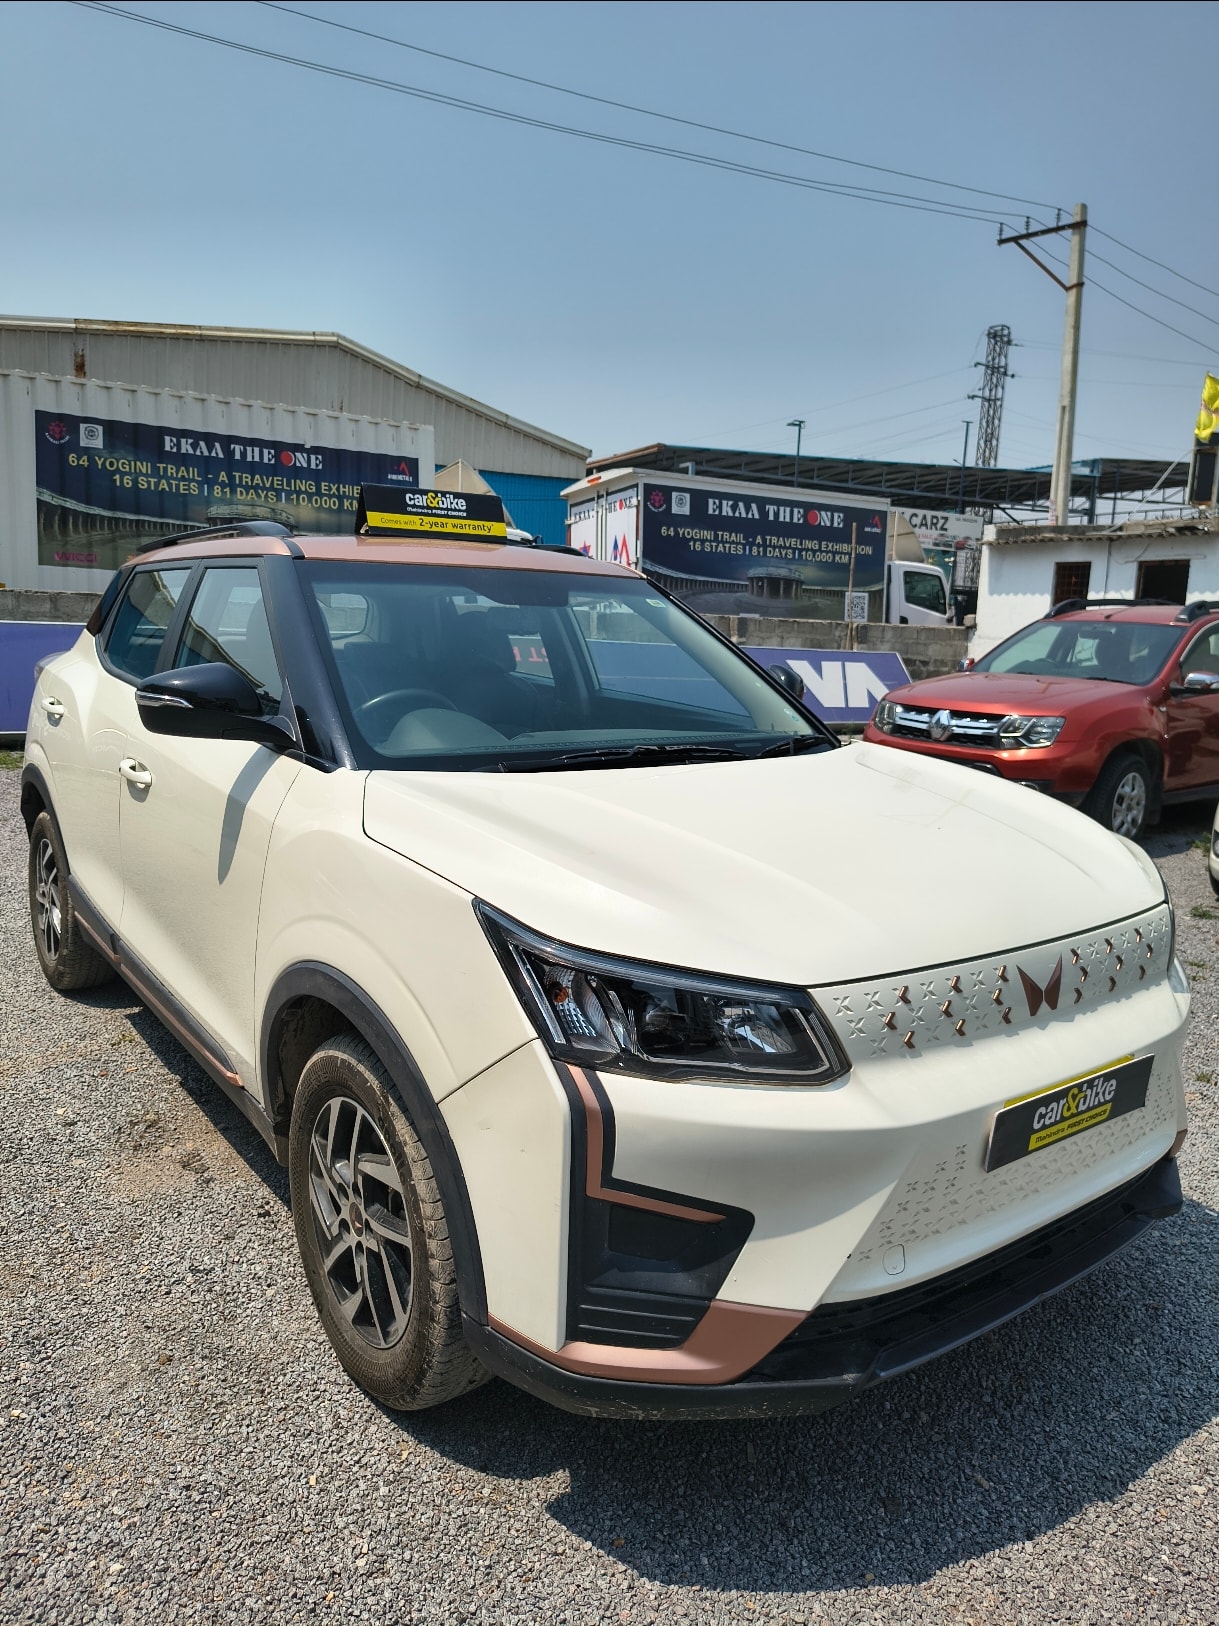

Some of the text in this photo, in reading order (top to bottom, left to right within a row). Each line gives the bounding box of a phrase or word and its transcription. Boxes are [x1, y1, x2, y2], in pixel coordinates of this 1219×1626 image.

[164, 436, 322, 469] EKAA THE ONE
[68, 453, 89, 467] 64
[95, 456, 151, 474] YOGINI
[157, 463, 202, 480] TRAIL
[218, 471, 229, 483] A
[233, 472, 315, 493] TRAVELING
[113, 474, 132, 488] 16
[138, 478, 199, 495] STATES
[213, 486, 230, 498] 81
[237, 488, 277, 502] DAYS
[291, 494, 339, 510] 10,000
[405, 492, 467, 510] car&bike
[380, 517, 401, 525] Comes
[419, 517, 449, 529] 2-year
[707, 498, 844, 528] EKAA THE ONE
[909, 513, 949, 531] CARZ
[661, 526, 675, 537] 64
[677, 527, 714, 539] YOGINI
[716, 531, 746, 543] TRAIL
[755, 535, 762, 545] A
[765, 536, 819, 550] TRAVELING
[688, 541, 701, 552] 16
[705, 543, 743, 555] STATES
[751, 547, 762, 556] 81
[767, 547, 793, 559] DAYS
[801, 552, 832, 563] 10,000
[1033, 1077, 1117, 1130] car&bike
[1035, 1108, 1109, 1144] Mahindra FIRST CHOICE
